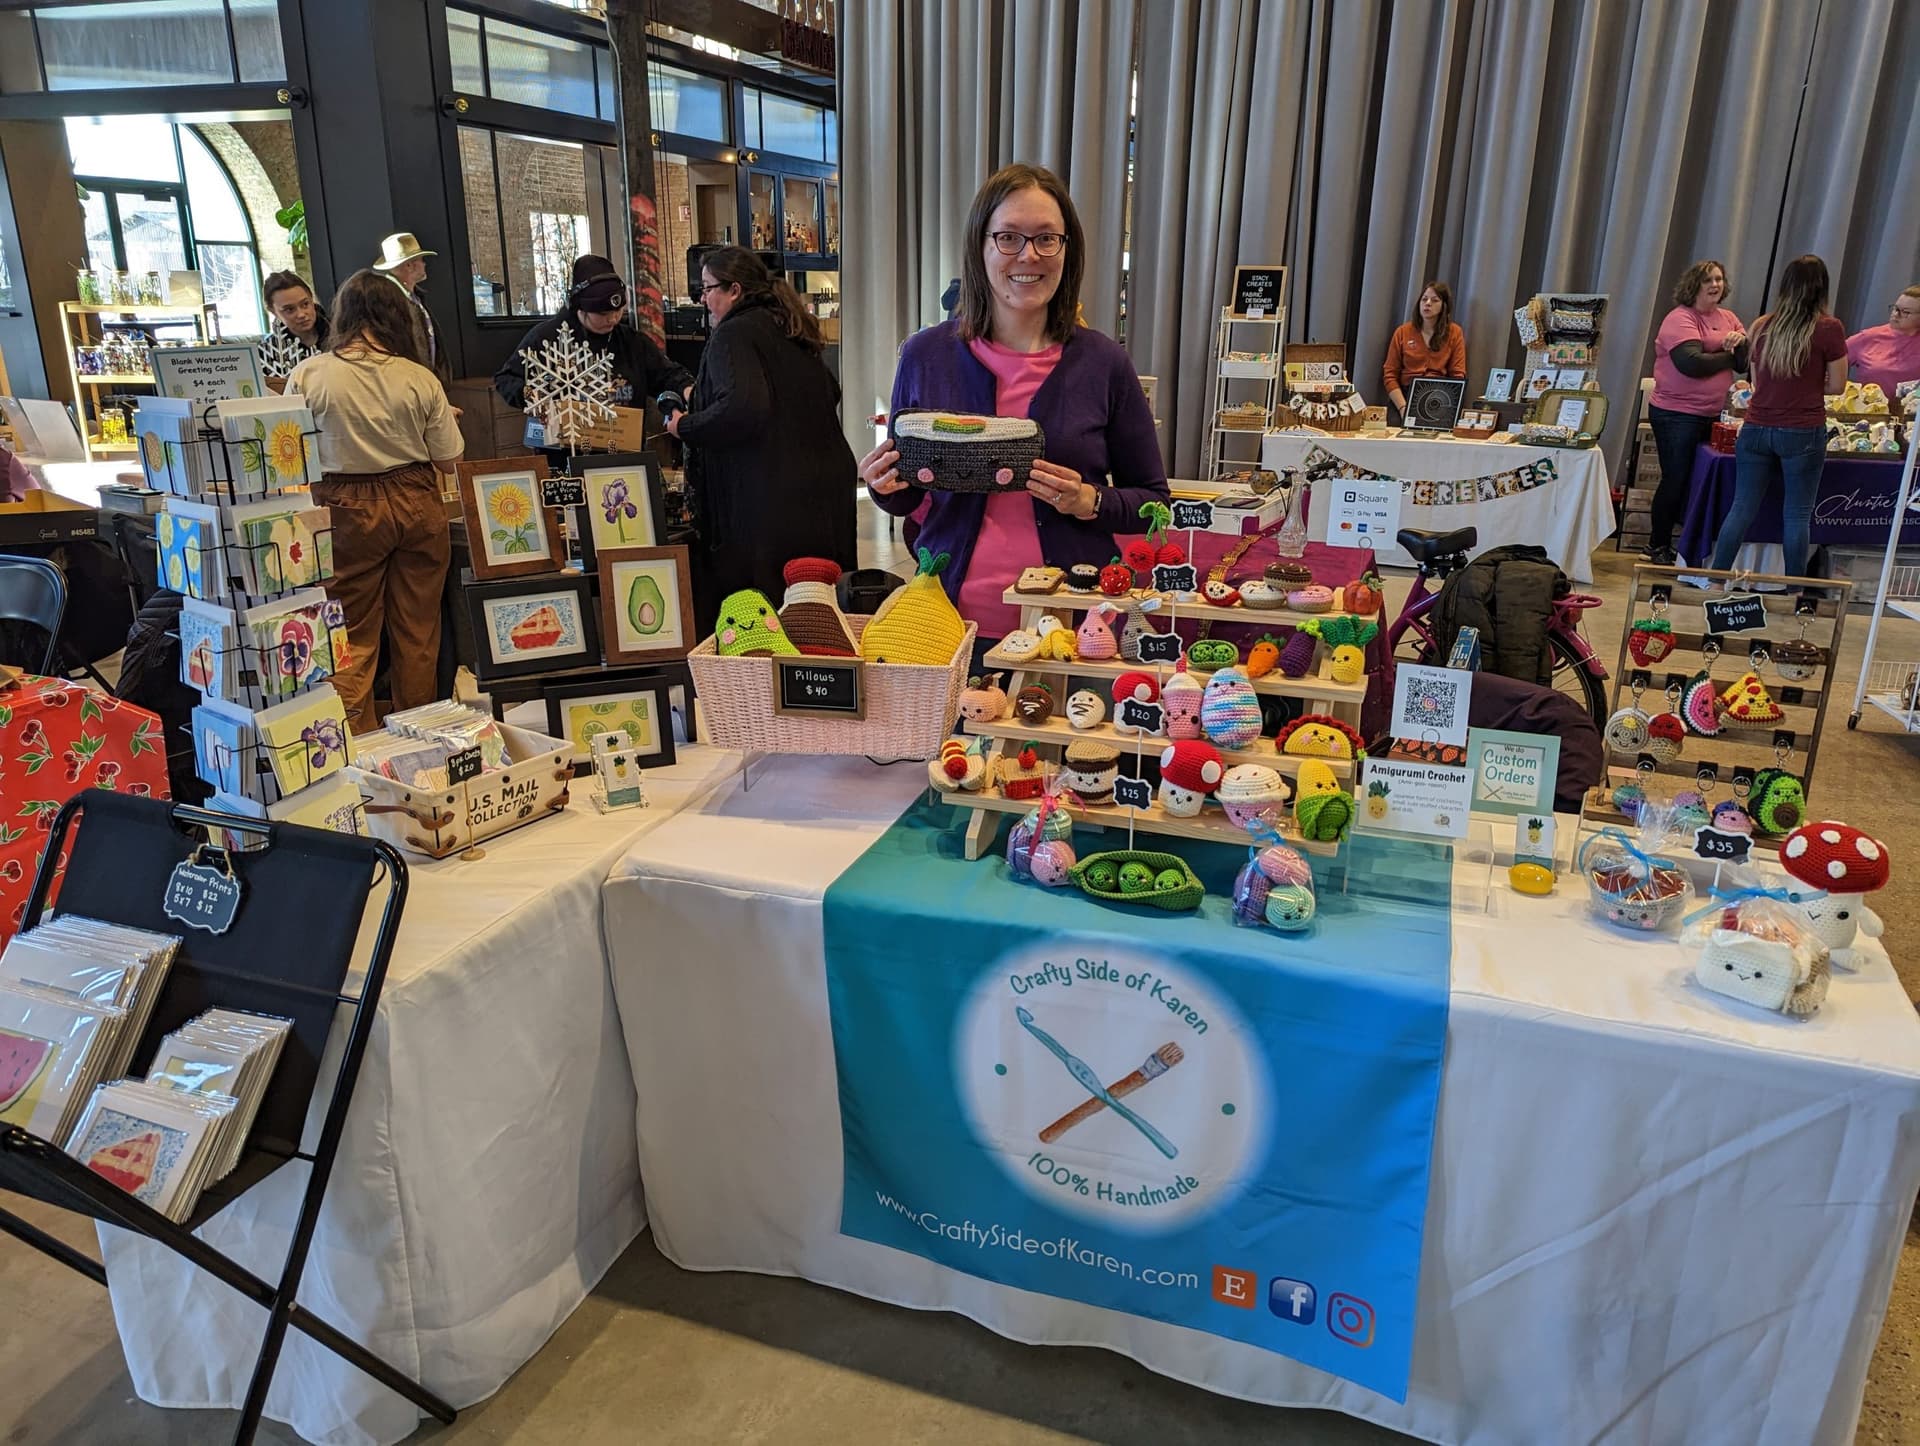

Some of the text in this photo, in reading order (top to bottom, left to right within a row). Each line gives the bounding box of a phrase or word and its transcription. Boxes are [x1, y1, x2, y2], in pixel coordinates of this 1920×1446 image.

[171, 355, 240, 365] Blank Watercolor
[192, 378, 226, 387] $4 each
[1290, 393, 1351, 421] CARDS
[1415, 461, 1555, 503] CREATES
[1358, 494, 1389, 504] Square
[1727, 616, 1746, 626] $10
[1149, 642, 1167, 652] $15
[795, 670, 835, 682] Pillows
[1131, 708, 1150, 721] $20
[1504, 744, 1525, 754] We do
[1483, 749, 1537, 770] Custom
[1370, 764, 1466, 783] Amigurumi Crochet
[1485, 766, 1535, 786] Orders
[502, 779, 539, 802] MAIL
[1122, 787, 1139, 800] $25
[466, 792, 538, 826] COLLECTION
[1706, 840, 1734, 853] $35
[176, 882, 218, 902] 8x10 $22
[209, 877, 232, 895] Prints
[174, 893, 191, 907] 5x7
[1010, 958, 1209, 1036] Crafty Side of Karen
[1028, 1152, 1199, 1206] 100% Handmade
[876, 1191, 1199, 1289] www.CraftySideofKaren.com
[1222, 1273, 1308, 1317] E f
